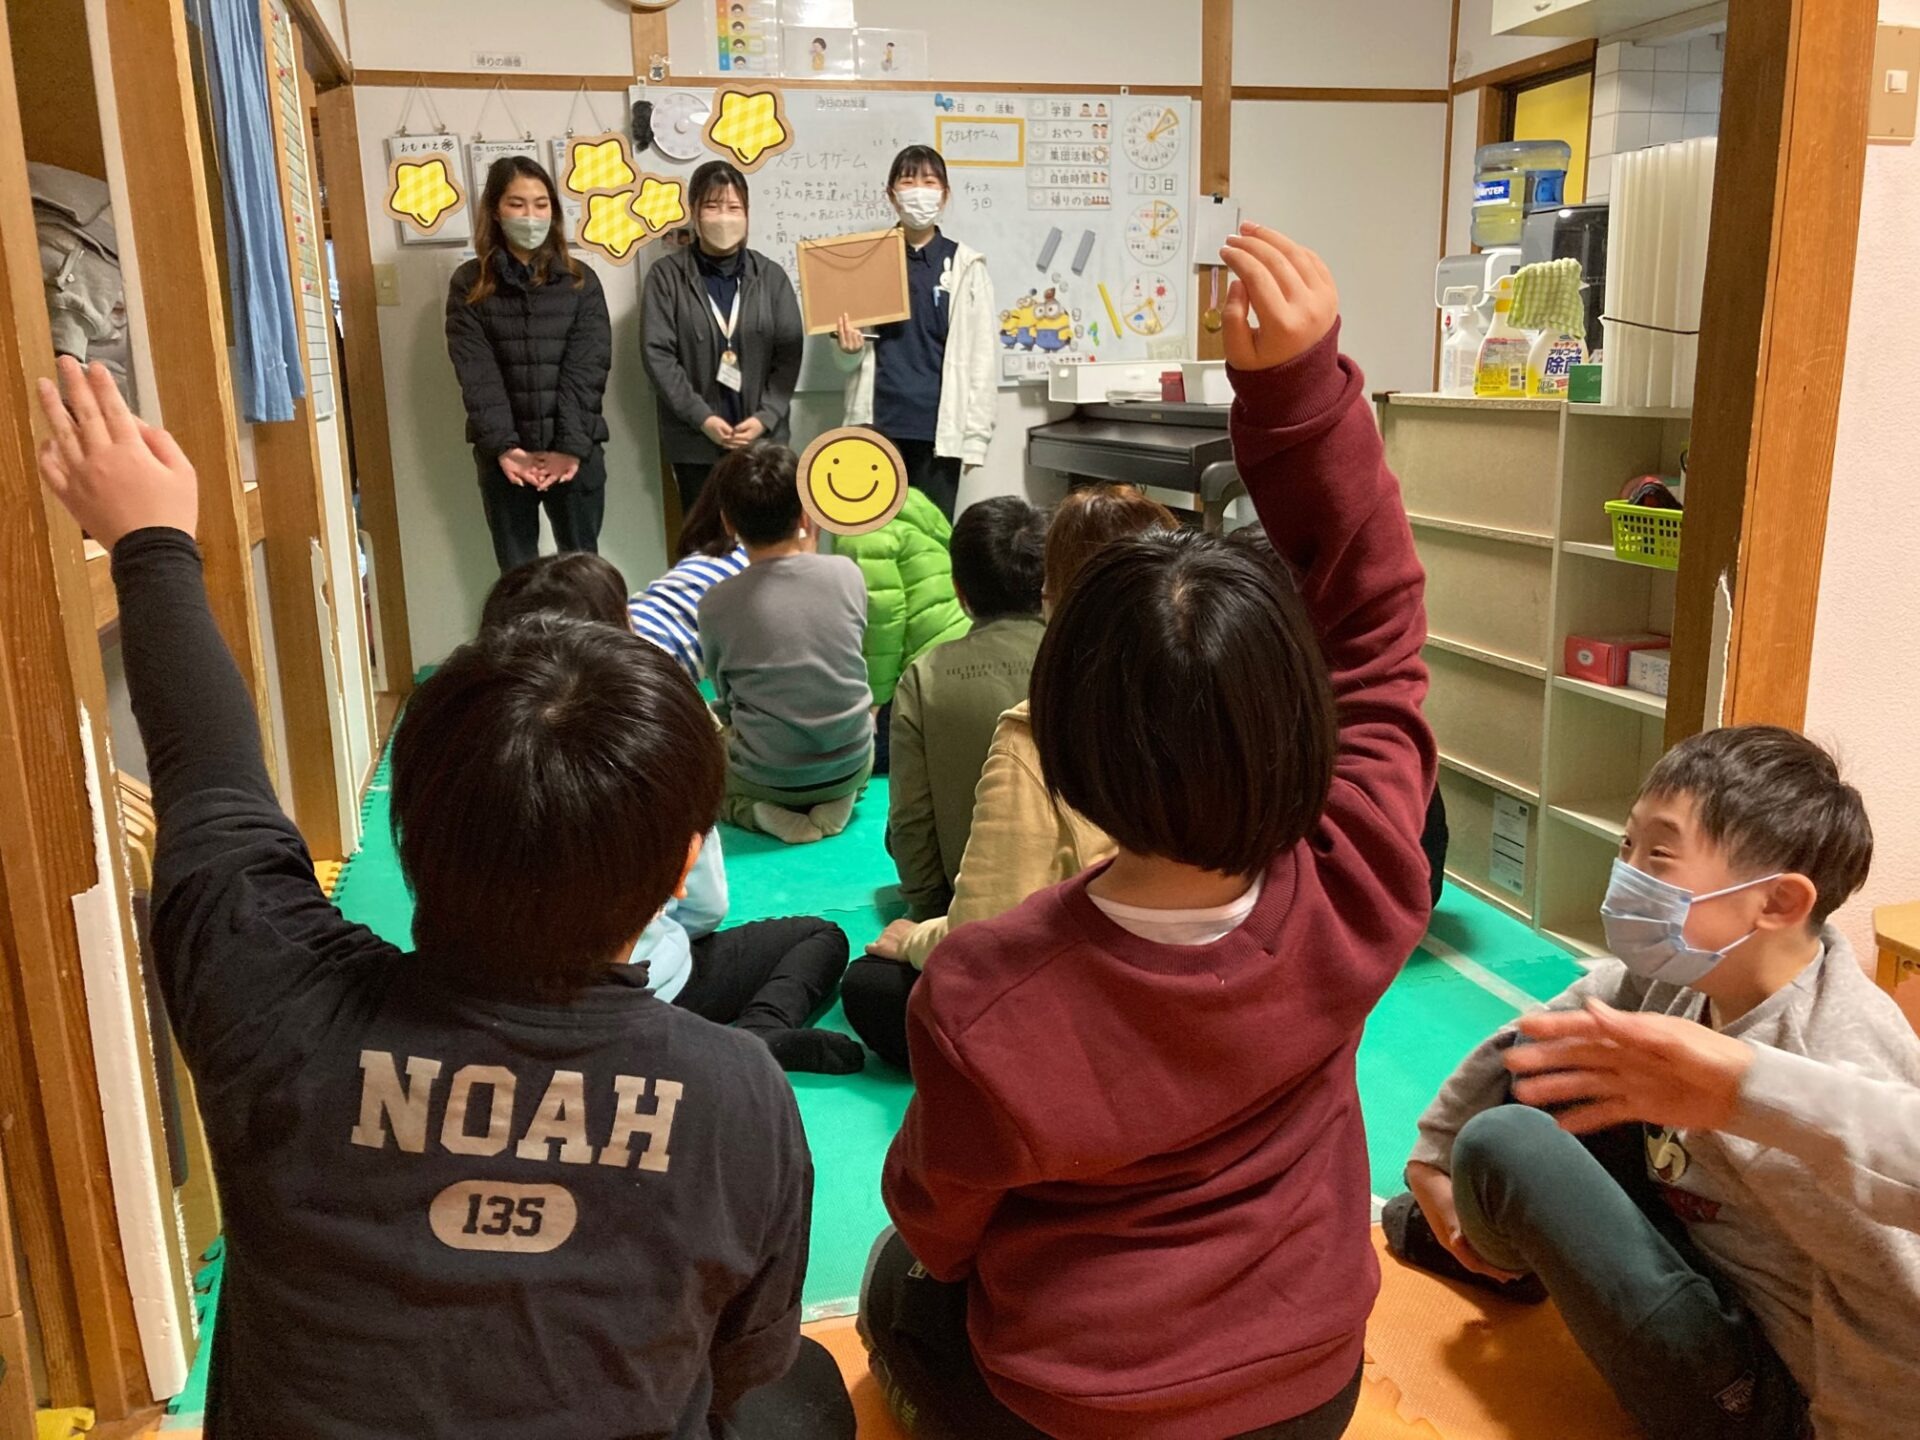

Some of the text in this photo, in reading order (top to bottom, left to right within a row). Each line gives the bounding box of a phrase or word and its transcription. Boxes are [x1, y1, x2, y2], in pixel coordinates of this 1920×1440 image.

[1050, 106, 1072, 117] 学習
[945, 128, 999, 145] ステレオゲーム
[1051, 128, 1083, 139] おやつ
[776, 148, 868, 171] ステレオゲーム
[1049, 150, 1092, 163] 集団活動
[1049, 173, 1091, 185] 自由時間
[1549, 348, 1582, 356] アルコール
[351, 1050, 684, 1172] NOAH
[462, 1193, 546, 1237] 135
